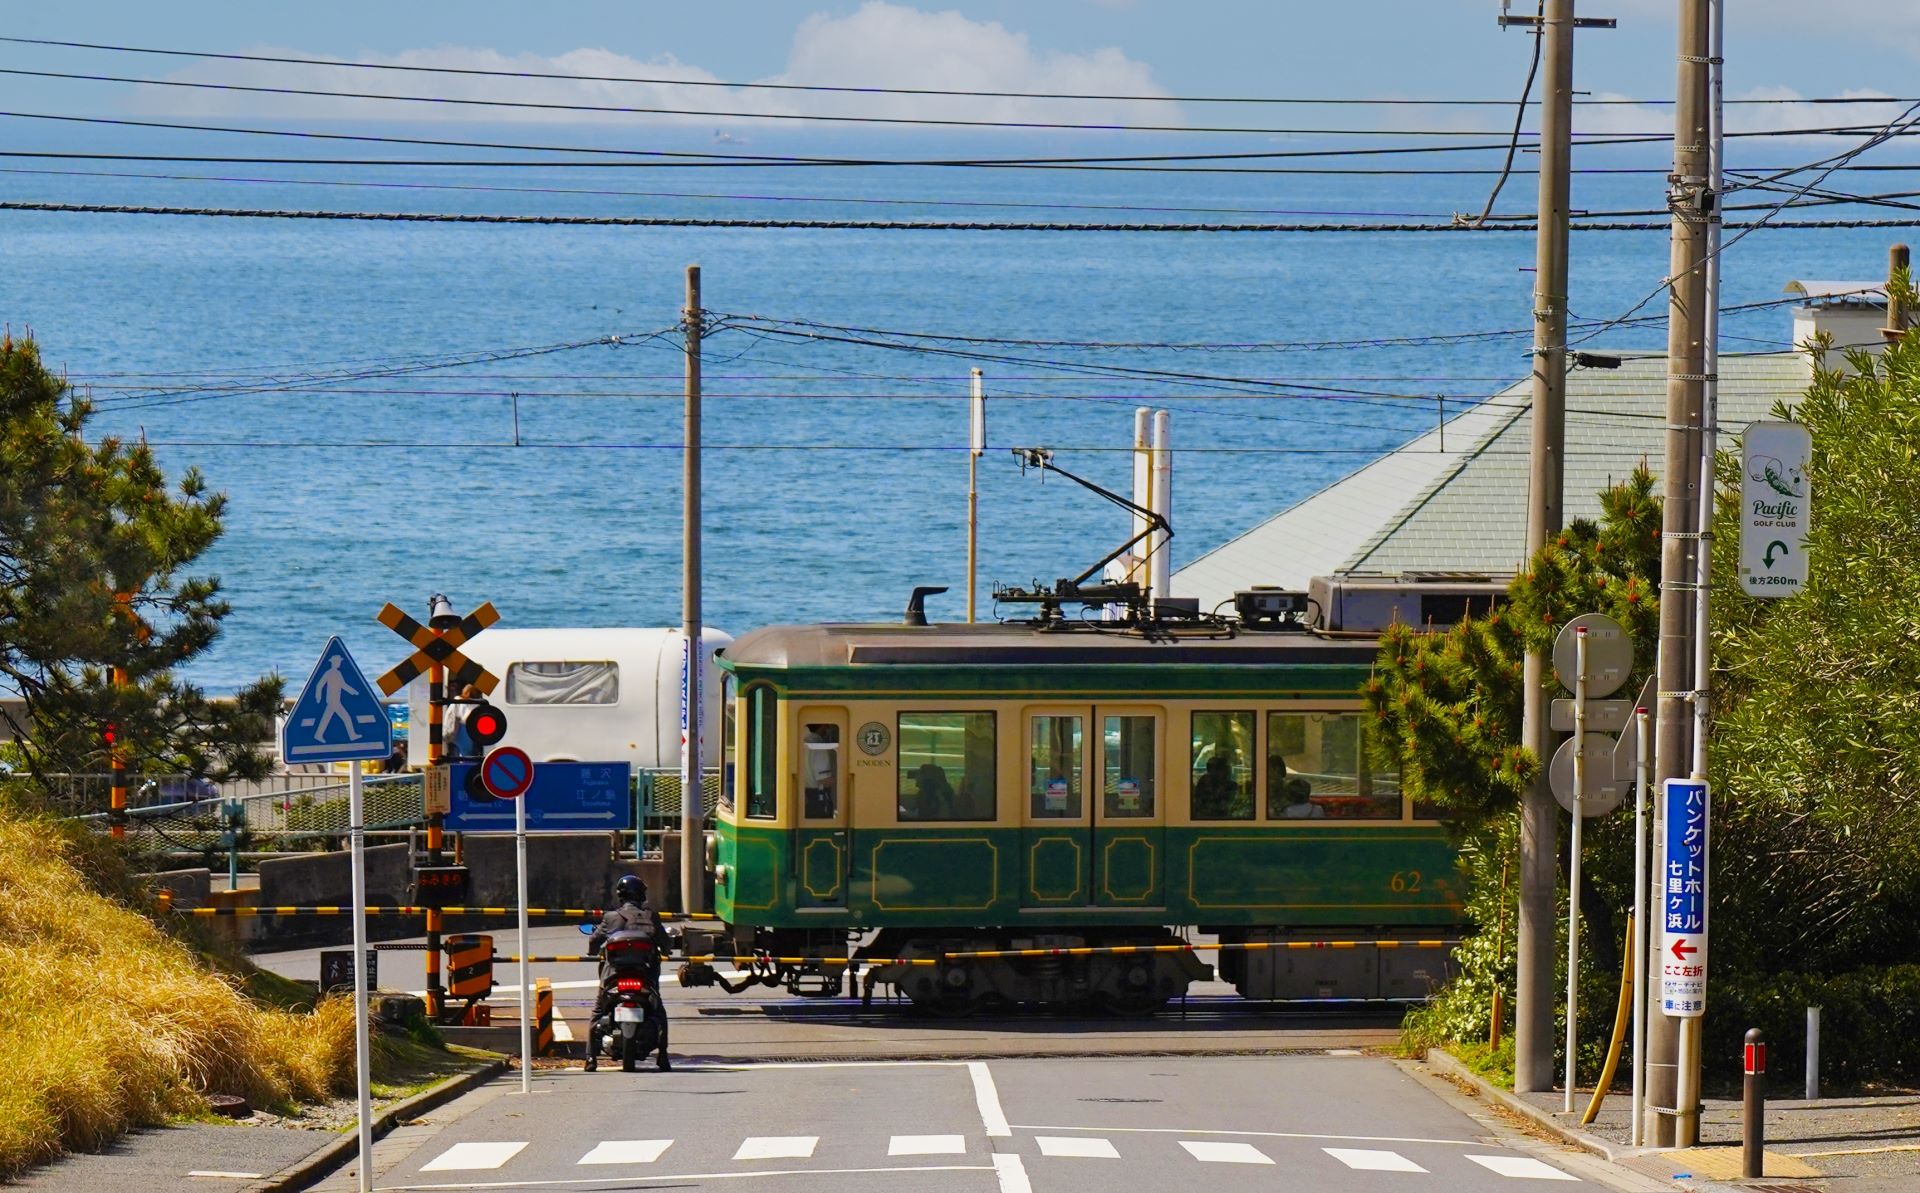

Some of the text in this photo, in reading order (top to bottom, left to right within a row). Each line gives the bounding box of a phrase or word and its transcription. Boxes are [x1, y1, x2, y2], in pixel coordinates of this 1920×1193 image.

[1752, 499, 1798, 520] Pacific
[1775, 520, 1797, 528] CLUB
[1749, 576, 1798, 586] 後方260m
[1684, 789, 1703, 930] バンケットホール
[1391, 870, 1421, 894] 62
[1664, 965, 1704, 977] ここ左折
[1664, 999, 1702, 1012] 車に注意
